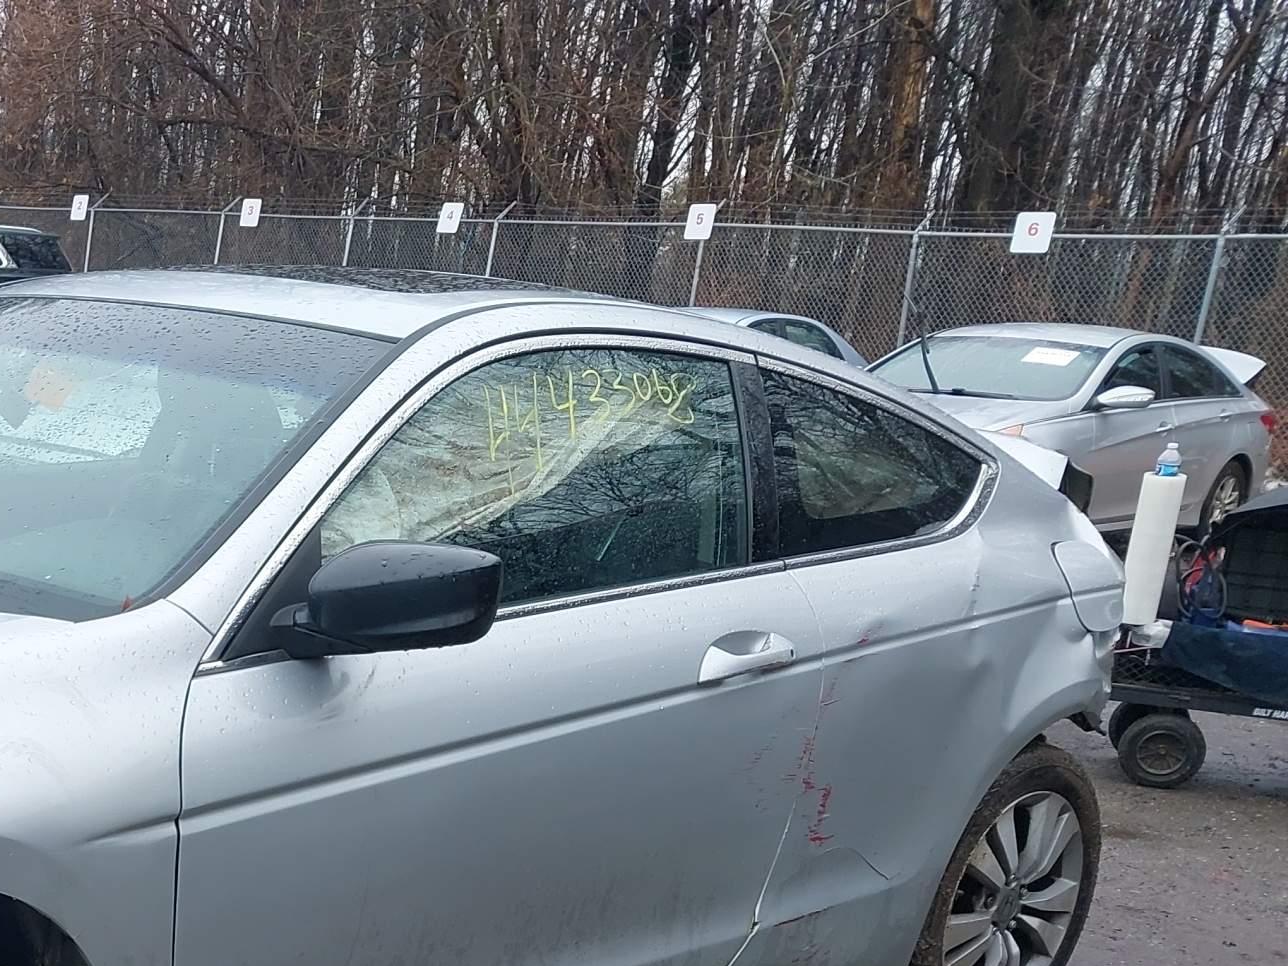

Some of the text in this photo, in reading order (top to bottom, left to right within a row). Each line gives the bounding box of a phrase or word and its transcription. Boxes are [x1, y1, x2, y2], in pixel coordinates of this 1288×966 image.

[247, 205, 254, 216] 3
[447, 210, 454, 221] 4
[696, 212, 704, 225] 5
[1028, 222, 1040, 237] 6
